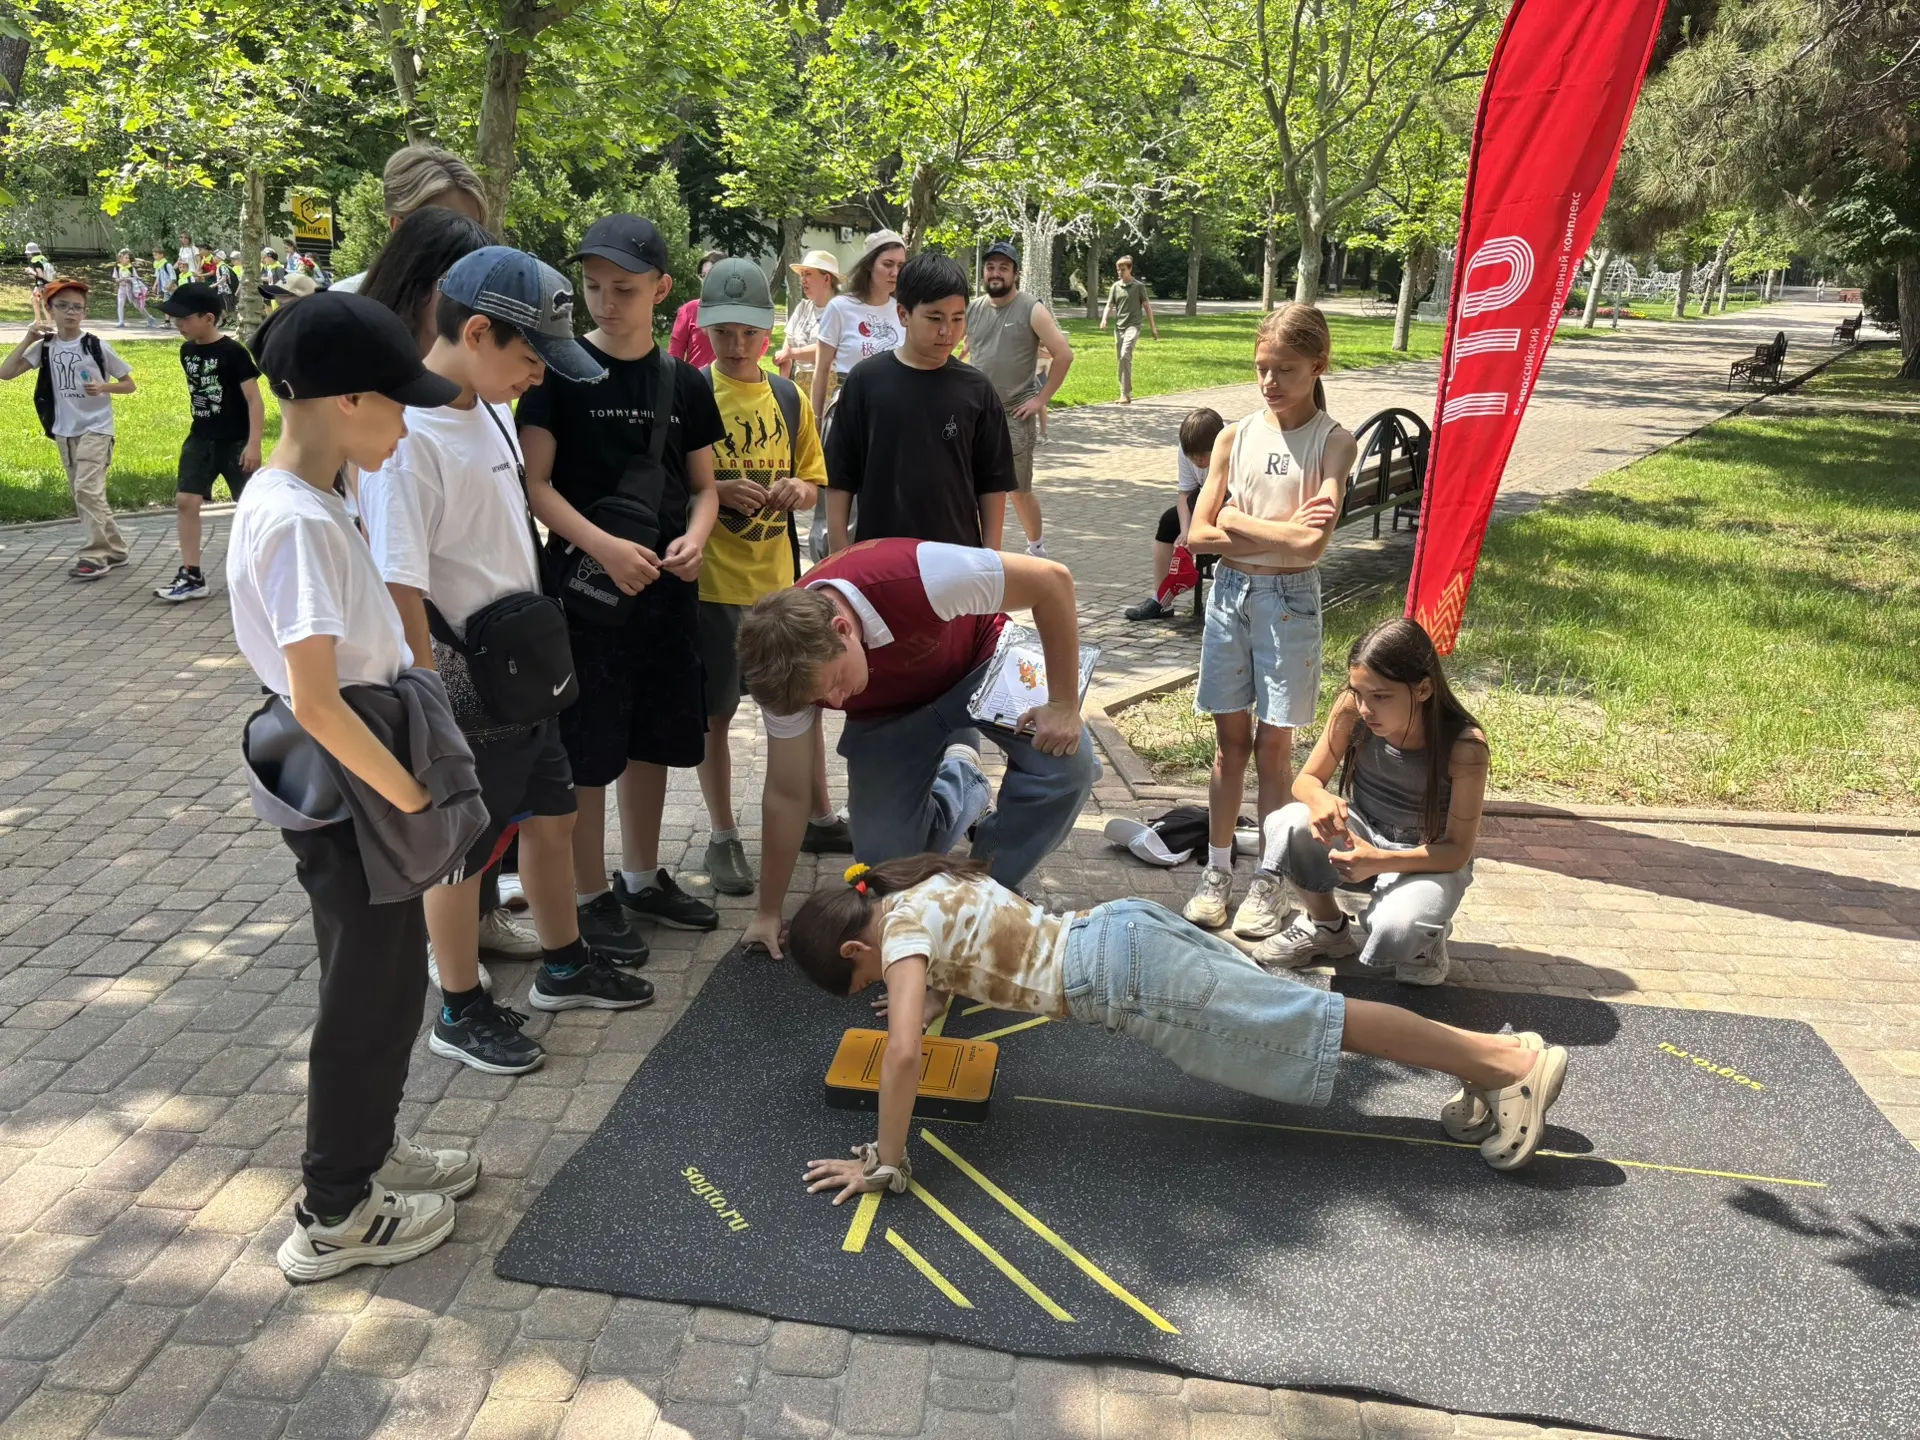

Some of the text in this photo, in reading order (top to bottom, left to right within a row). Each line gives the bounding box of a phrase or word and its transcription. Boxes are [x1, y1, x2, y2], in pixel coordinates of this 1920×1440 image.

[1563, 192, 1581, 251] комплекс
[589, 409, 630, 418] TOMMY
[640, 410, 681, 425] HILER
[1264, 452, 1281, 475] R
[1657, 1042, 1766, 1091] sogto.ru
[681, 1167, 749, 1231] sogto.ru
